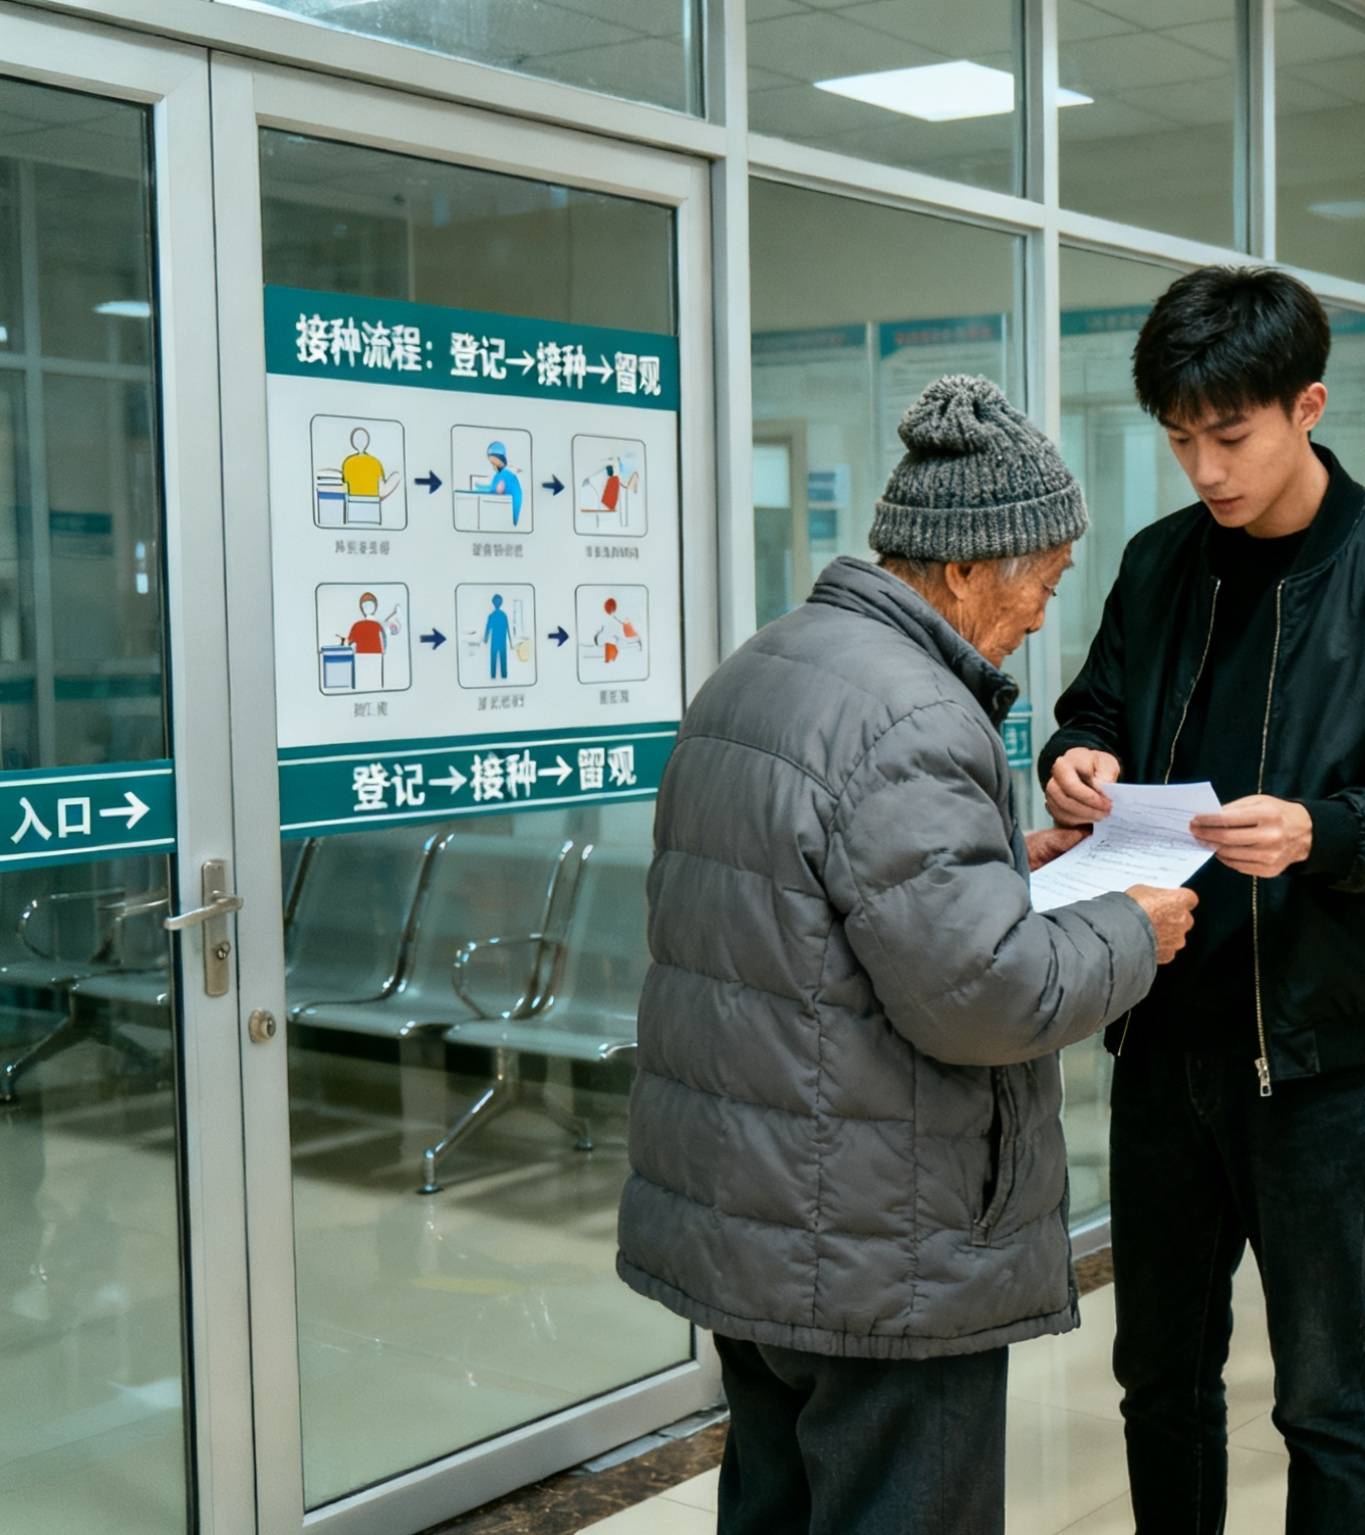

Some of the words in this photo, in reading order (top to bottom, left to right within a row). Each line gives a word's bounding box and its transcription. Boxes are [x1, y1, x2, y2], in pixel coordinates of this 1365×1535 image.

[352, 763, 426, 812] 登记
[470, 749, 537, 801] 接种
[10, 797, 91, 844] 入口
